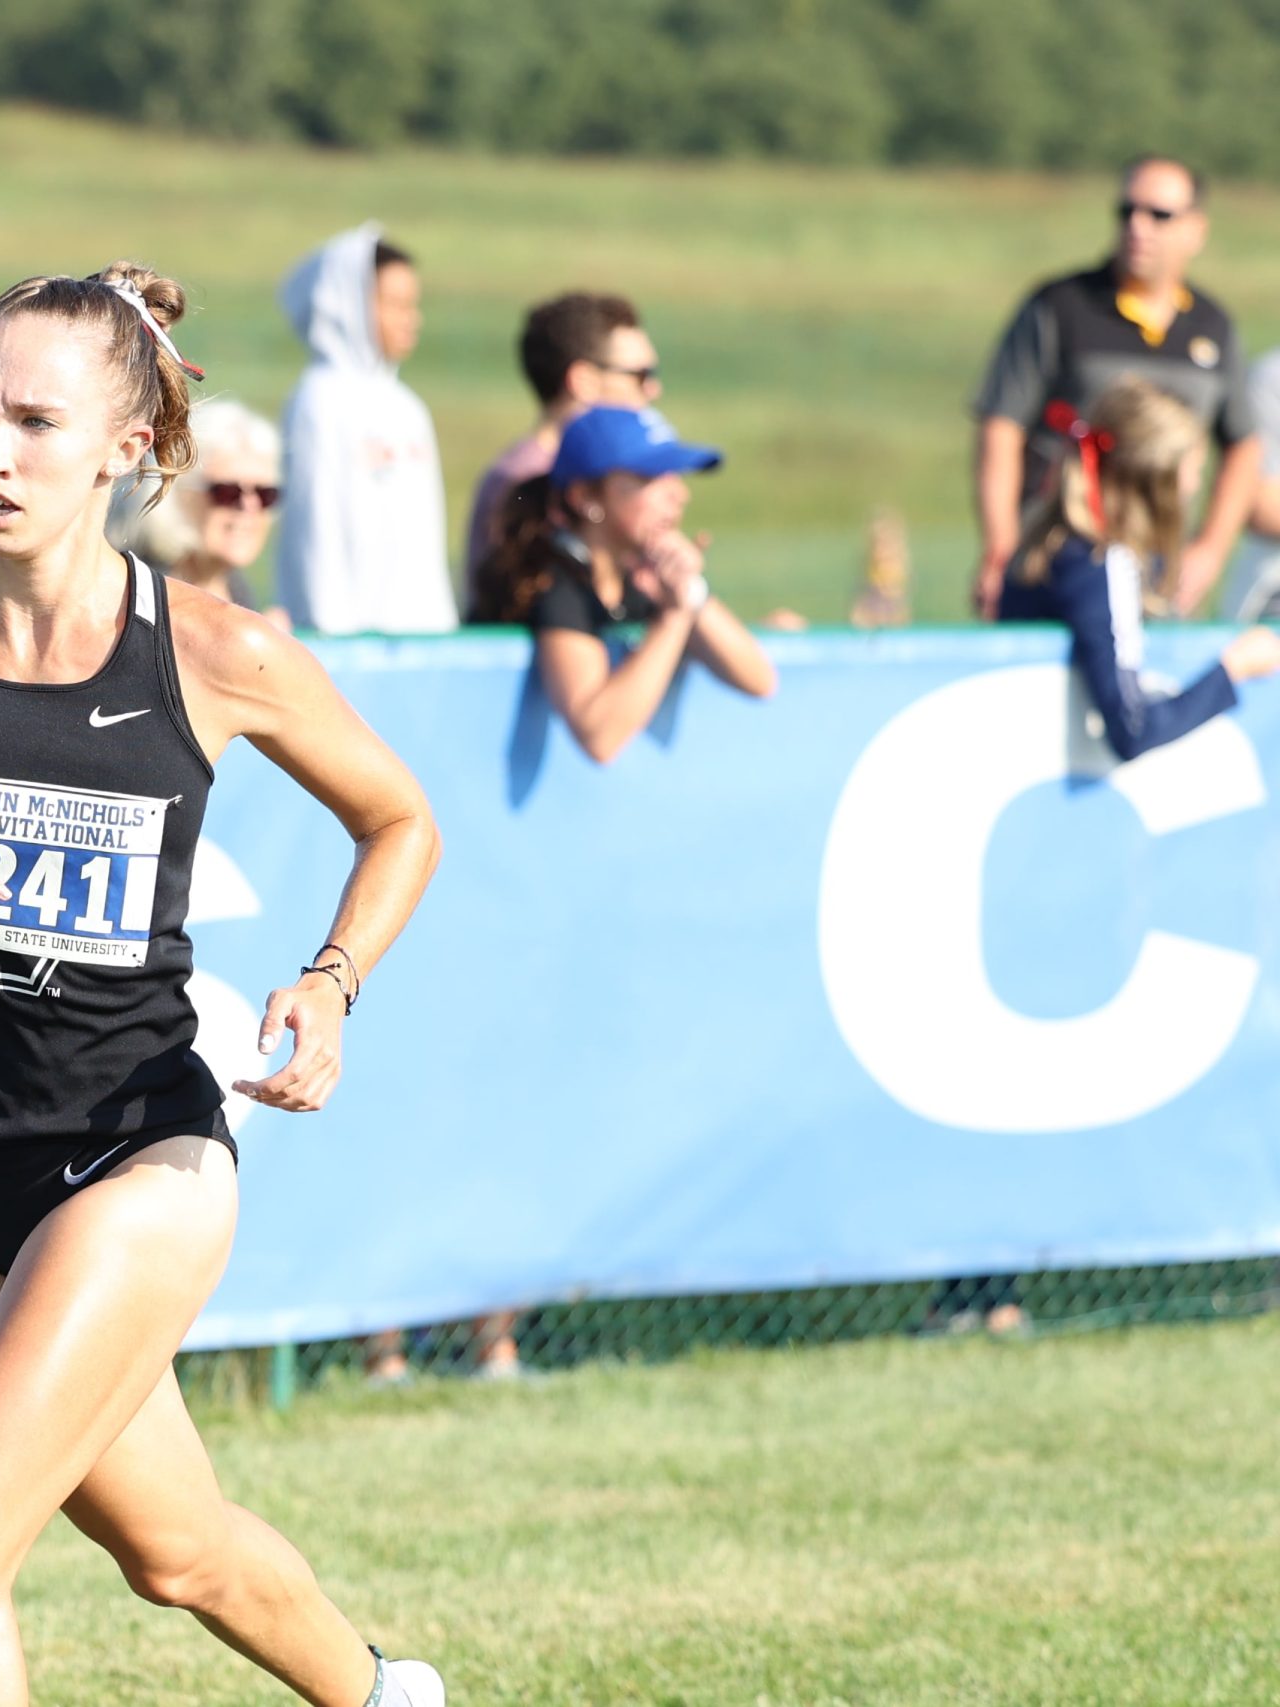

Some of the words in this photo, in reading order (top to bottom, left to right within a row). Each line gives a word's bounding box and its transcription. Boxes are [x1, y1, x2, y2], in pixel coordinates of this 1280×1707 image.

[26, 795, 145, 827] McNICHOLS
[4, 930, 47, 947] STATE
[51, 936, 128, 956] UNIVERSITY
[45, 986, 61, 998] TM
